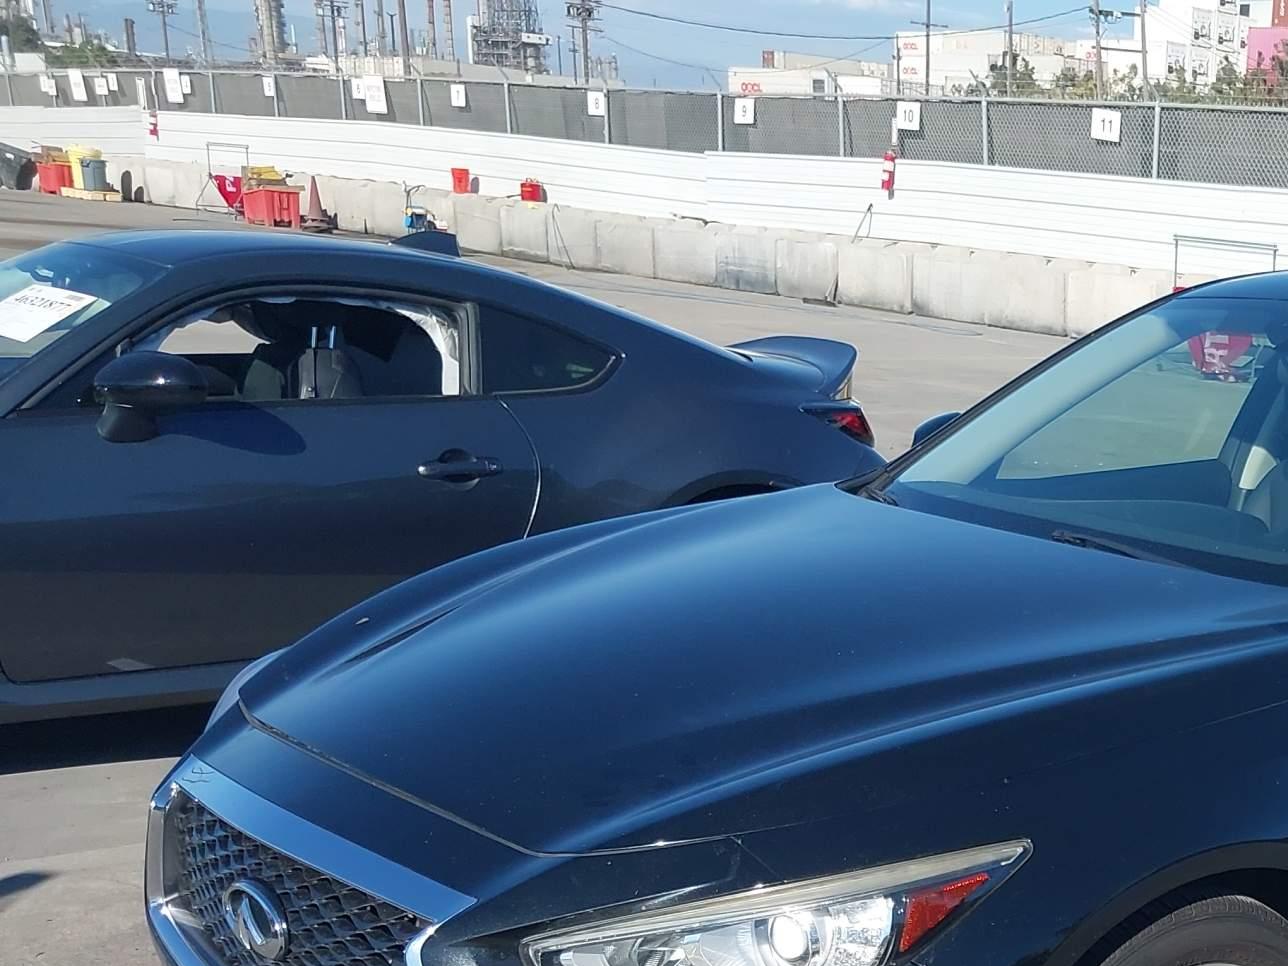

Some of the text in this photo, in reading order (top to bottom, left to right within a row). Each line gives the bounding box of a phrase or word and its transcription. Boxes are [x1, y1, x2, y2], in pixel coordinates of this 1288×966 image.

[741, 105, 747, 118] 9
[903, 109, 914, 123] 10
[1101, 117, 1112, 133] 11
